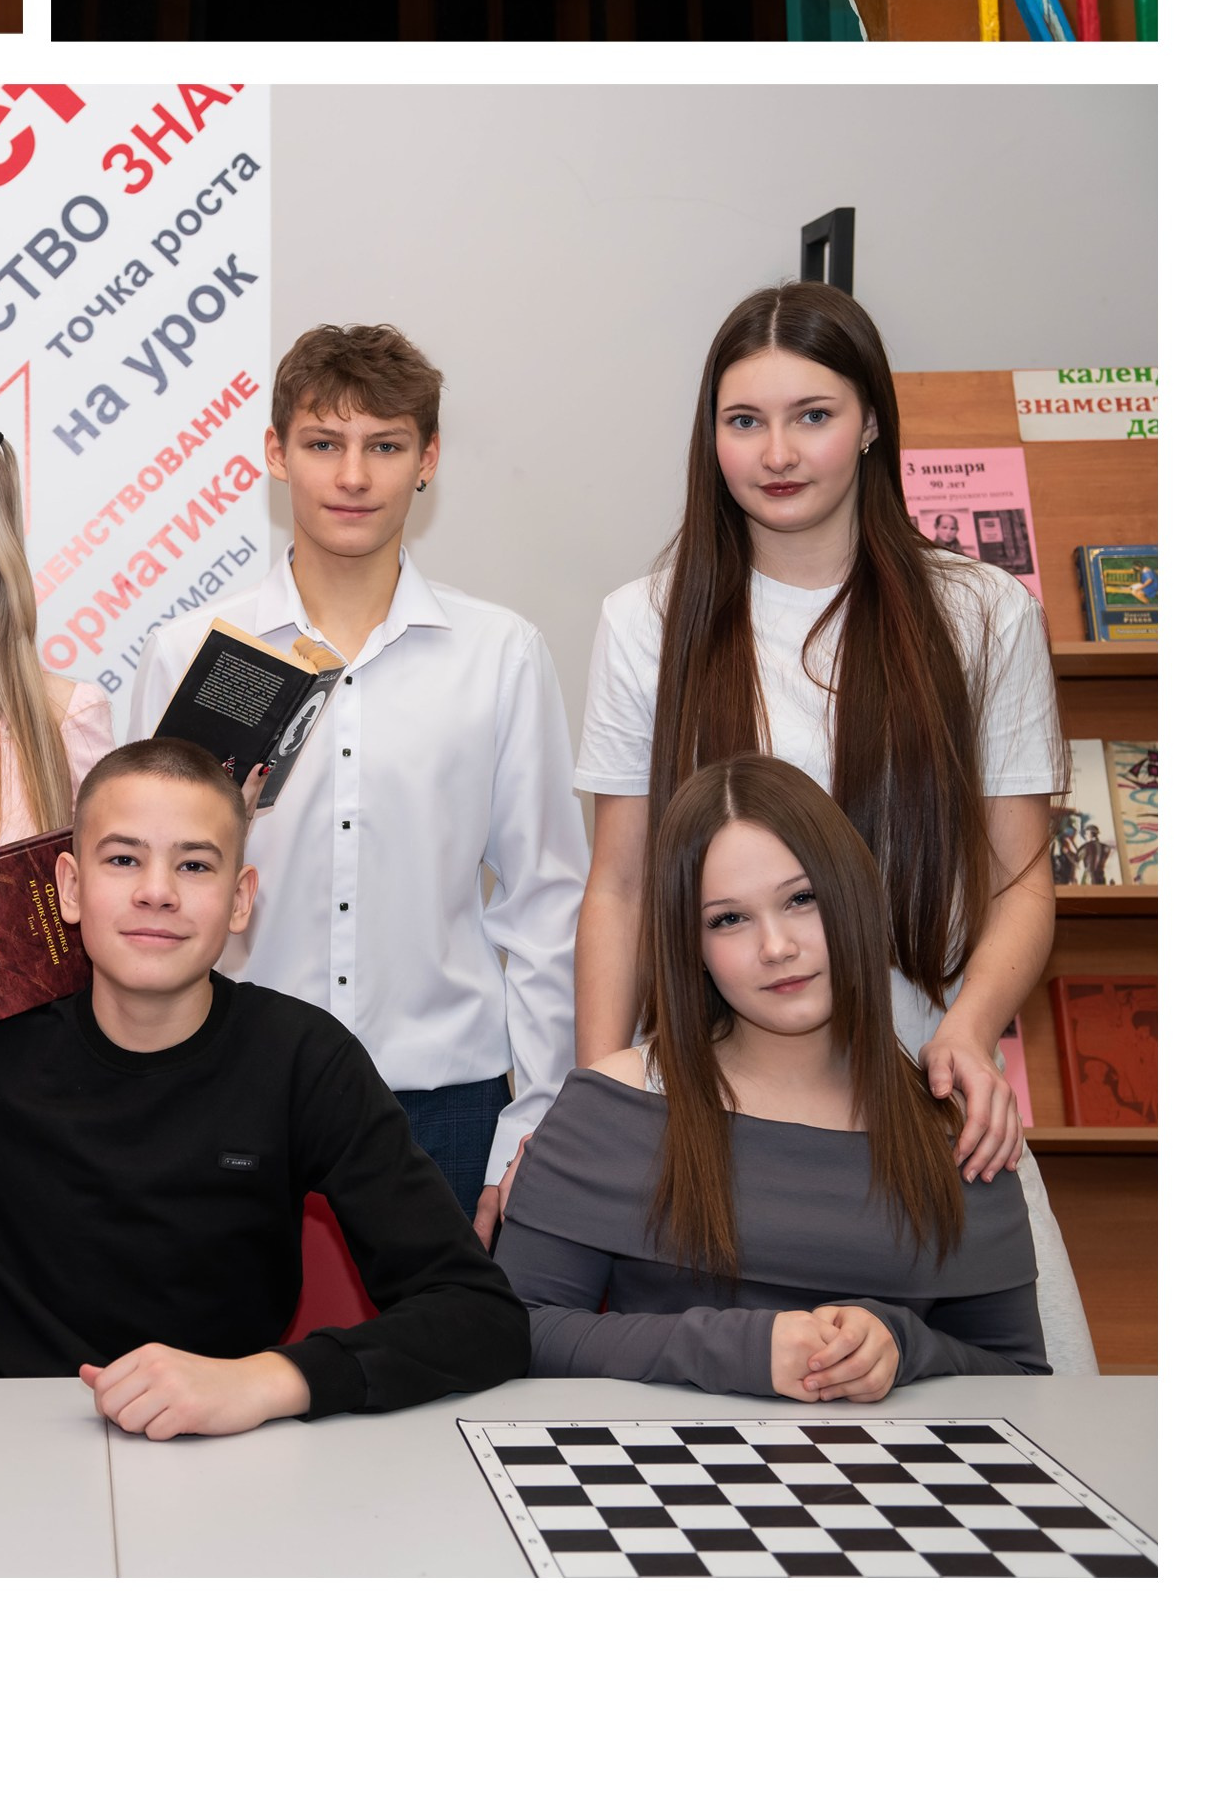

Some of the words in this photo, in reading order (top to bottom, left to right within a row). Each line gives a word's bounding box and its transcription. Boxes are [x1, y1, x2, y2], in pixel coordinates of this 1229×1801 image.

[102, 84, 244, 195] ЗНА
[45, 259, 154, 359] точка
[150, 152, 261, 266] роста
[52, 383, 130, 456] на
[121, 252, 259, 396] урок
[1058, 367, 1158, 386] кален
[1017, 395, 1158, 415] знамена
[906, 462, 916, 476] 3
[921, 462, 985, 477] января
[929, 480, 944, 489] 90
[946, 480, 966, 489] лет
[40, 454, 263, 670] орматика
[29, 879, 36, 887] и
[27, 913, 36, 932] Том
[31, 889, 60, 966] приключения
[44, 882, 69, 954] Фантастика
